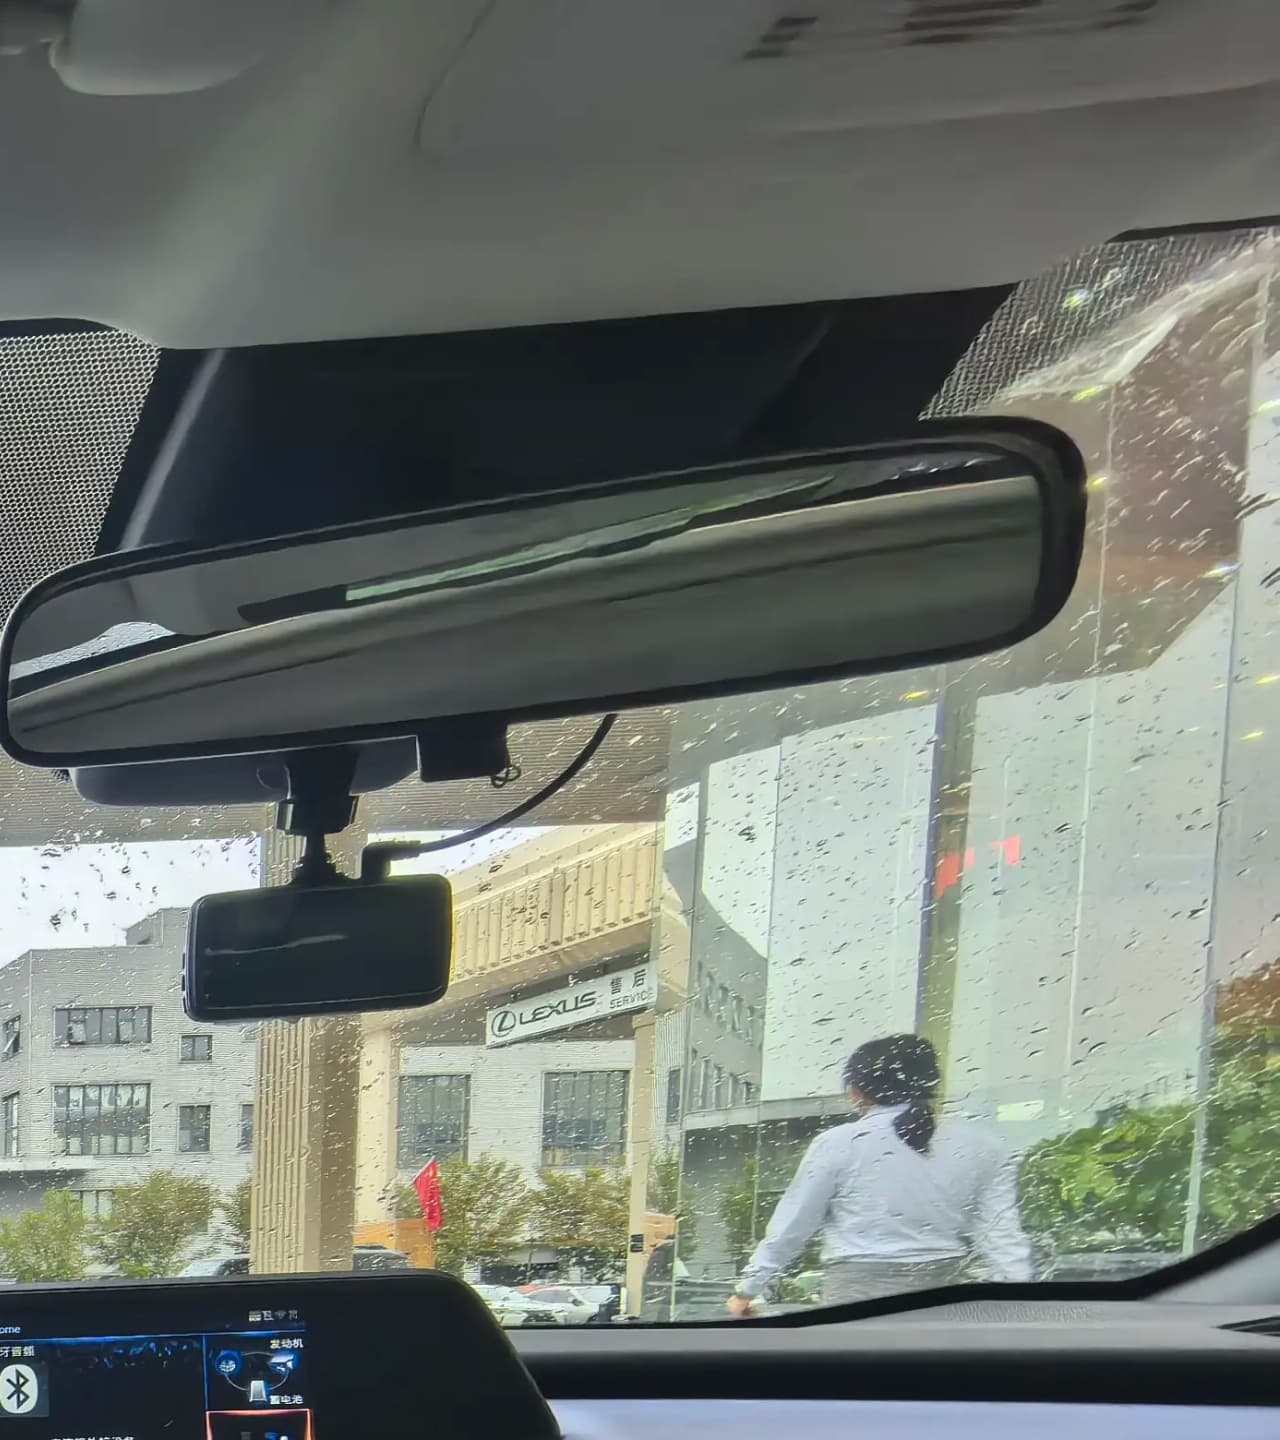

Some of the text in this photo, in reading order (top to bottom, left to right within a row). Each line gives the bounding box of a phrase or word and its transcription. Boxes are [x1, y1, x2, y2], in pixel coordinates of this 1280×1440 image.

[519, 990, 597, 1025] LEXUS
[269, 1337, 305, 1350] 发动机
